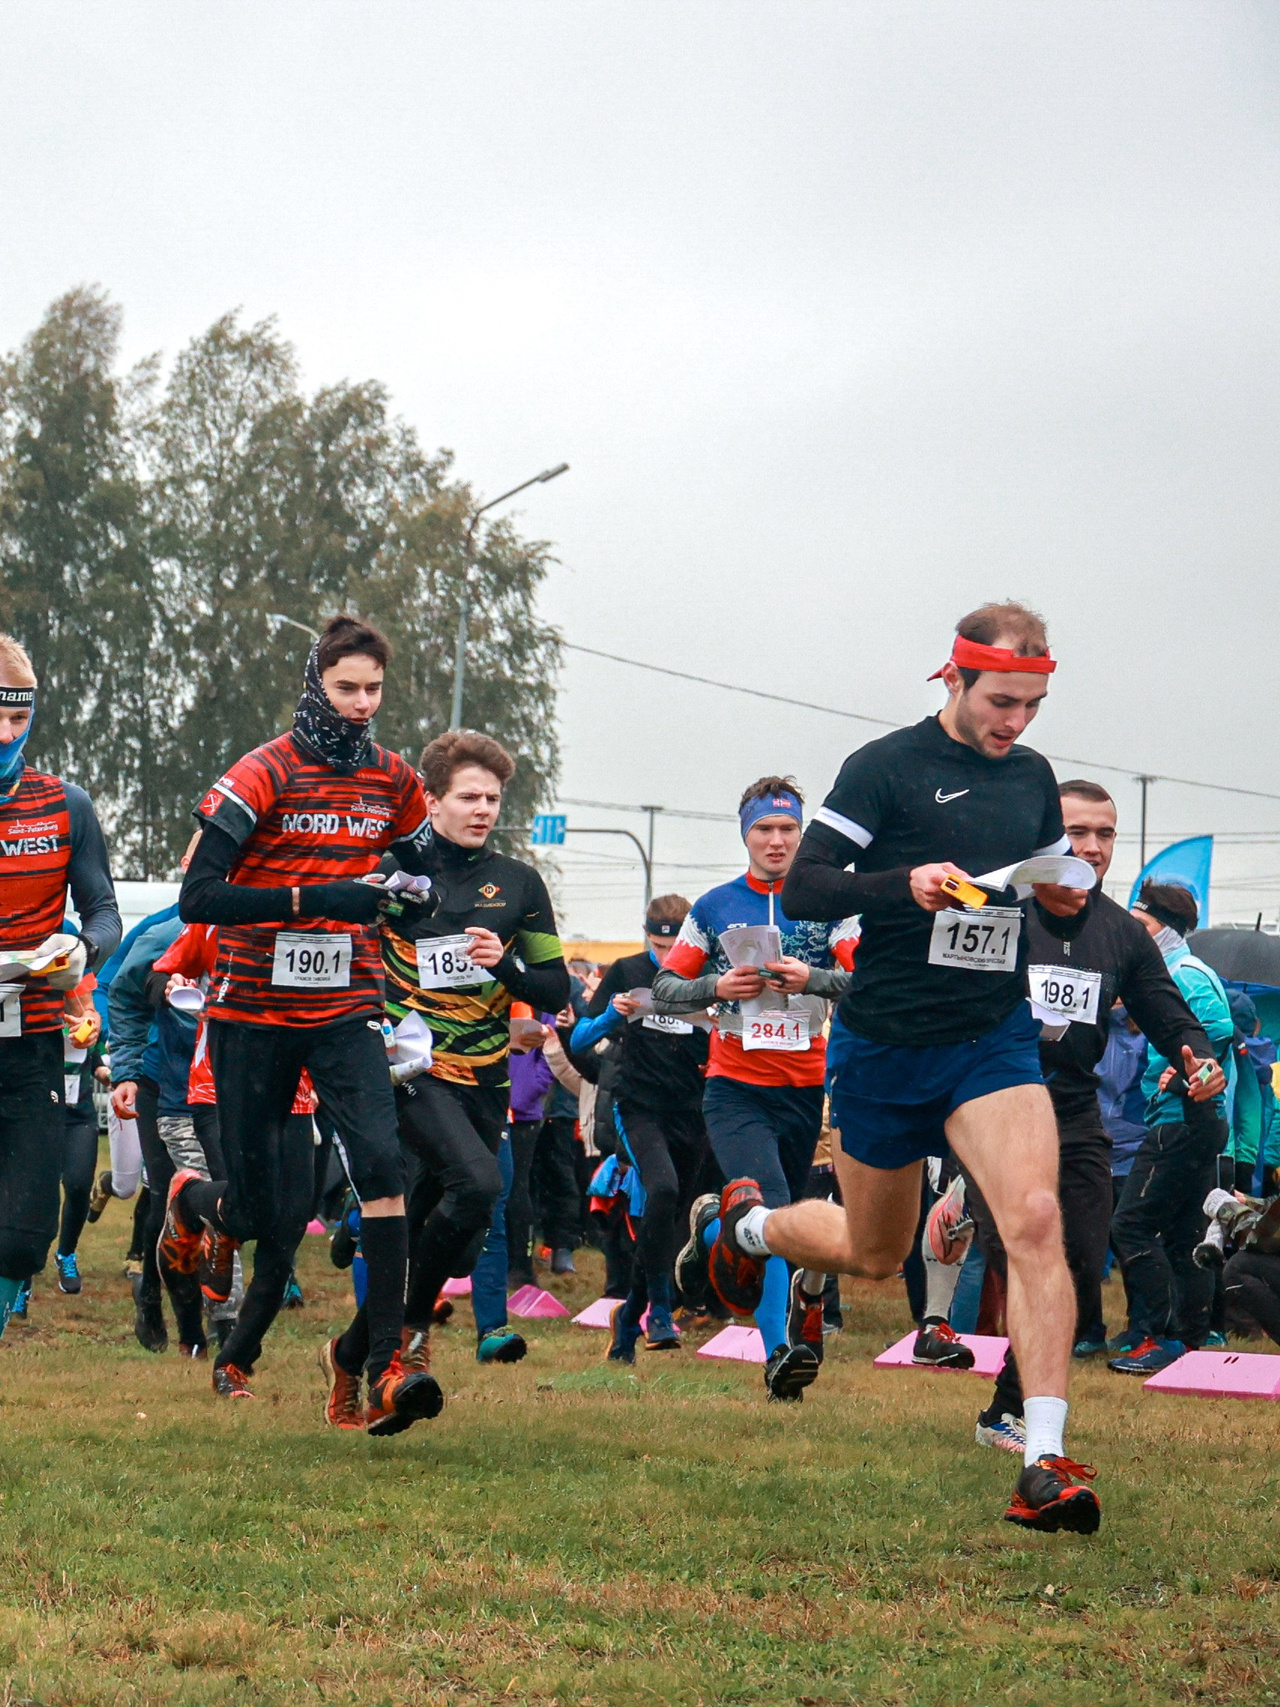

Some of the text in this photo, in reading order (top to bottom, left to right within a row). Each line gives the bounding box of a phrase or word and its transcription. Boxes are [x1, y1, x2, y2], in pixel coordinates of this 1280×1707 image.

[282, 813, 390, 839] NORD WES
[0, 834, 60, 857] WEST
[947, 922, 1011, 955] 157.1
[286, 949, 340, 974] 190.1
[428, 951, 486, 975] 185.
[1041, 980, 1090, 1010] 198.1
[751, 1023, 801, 1040] 284.1
